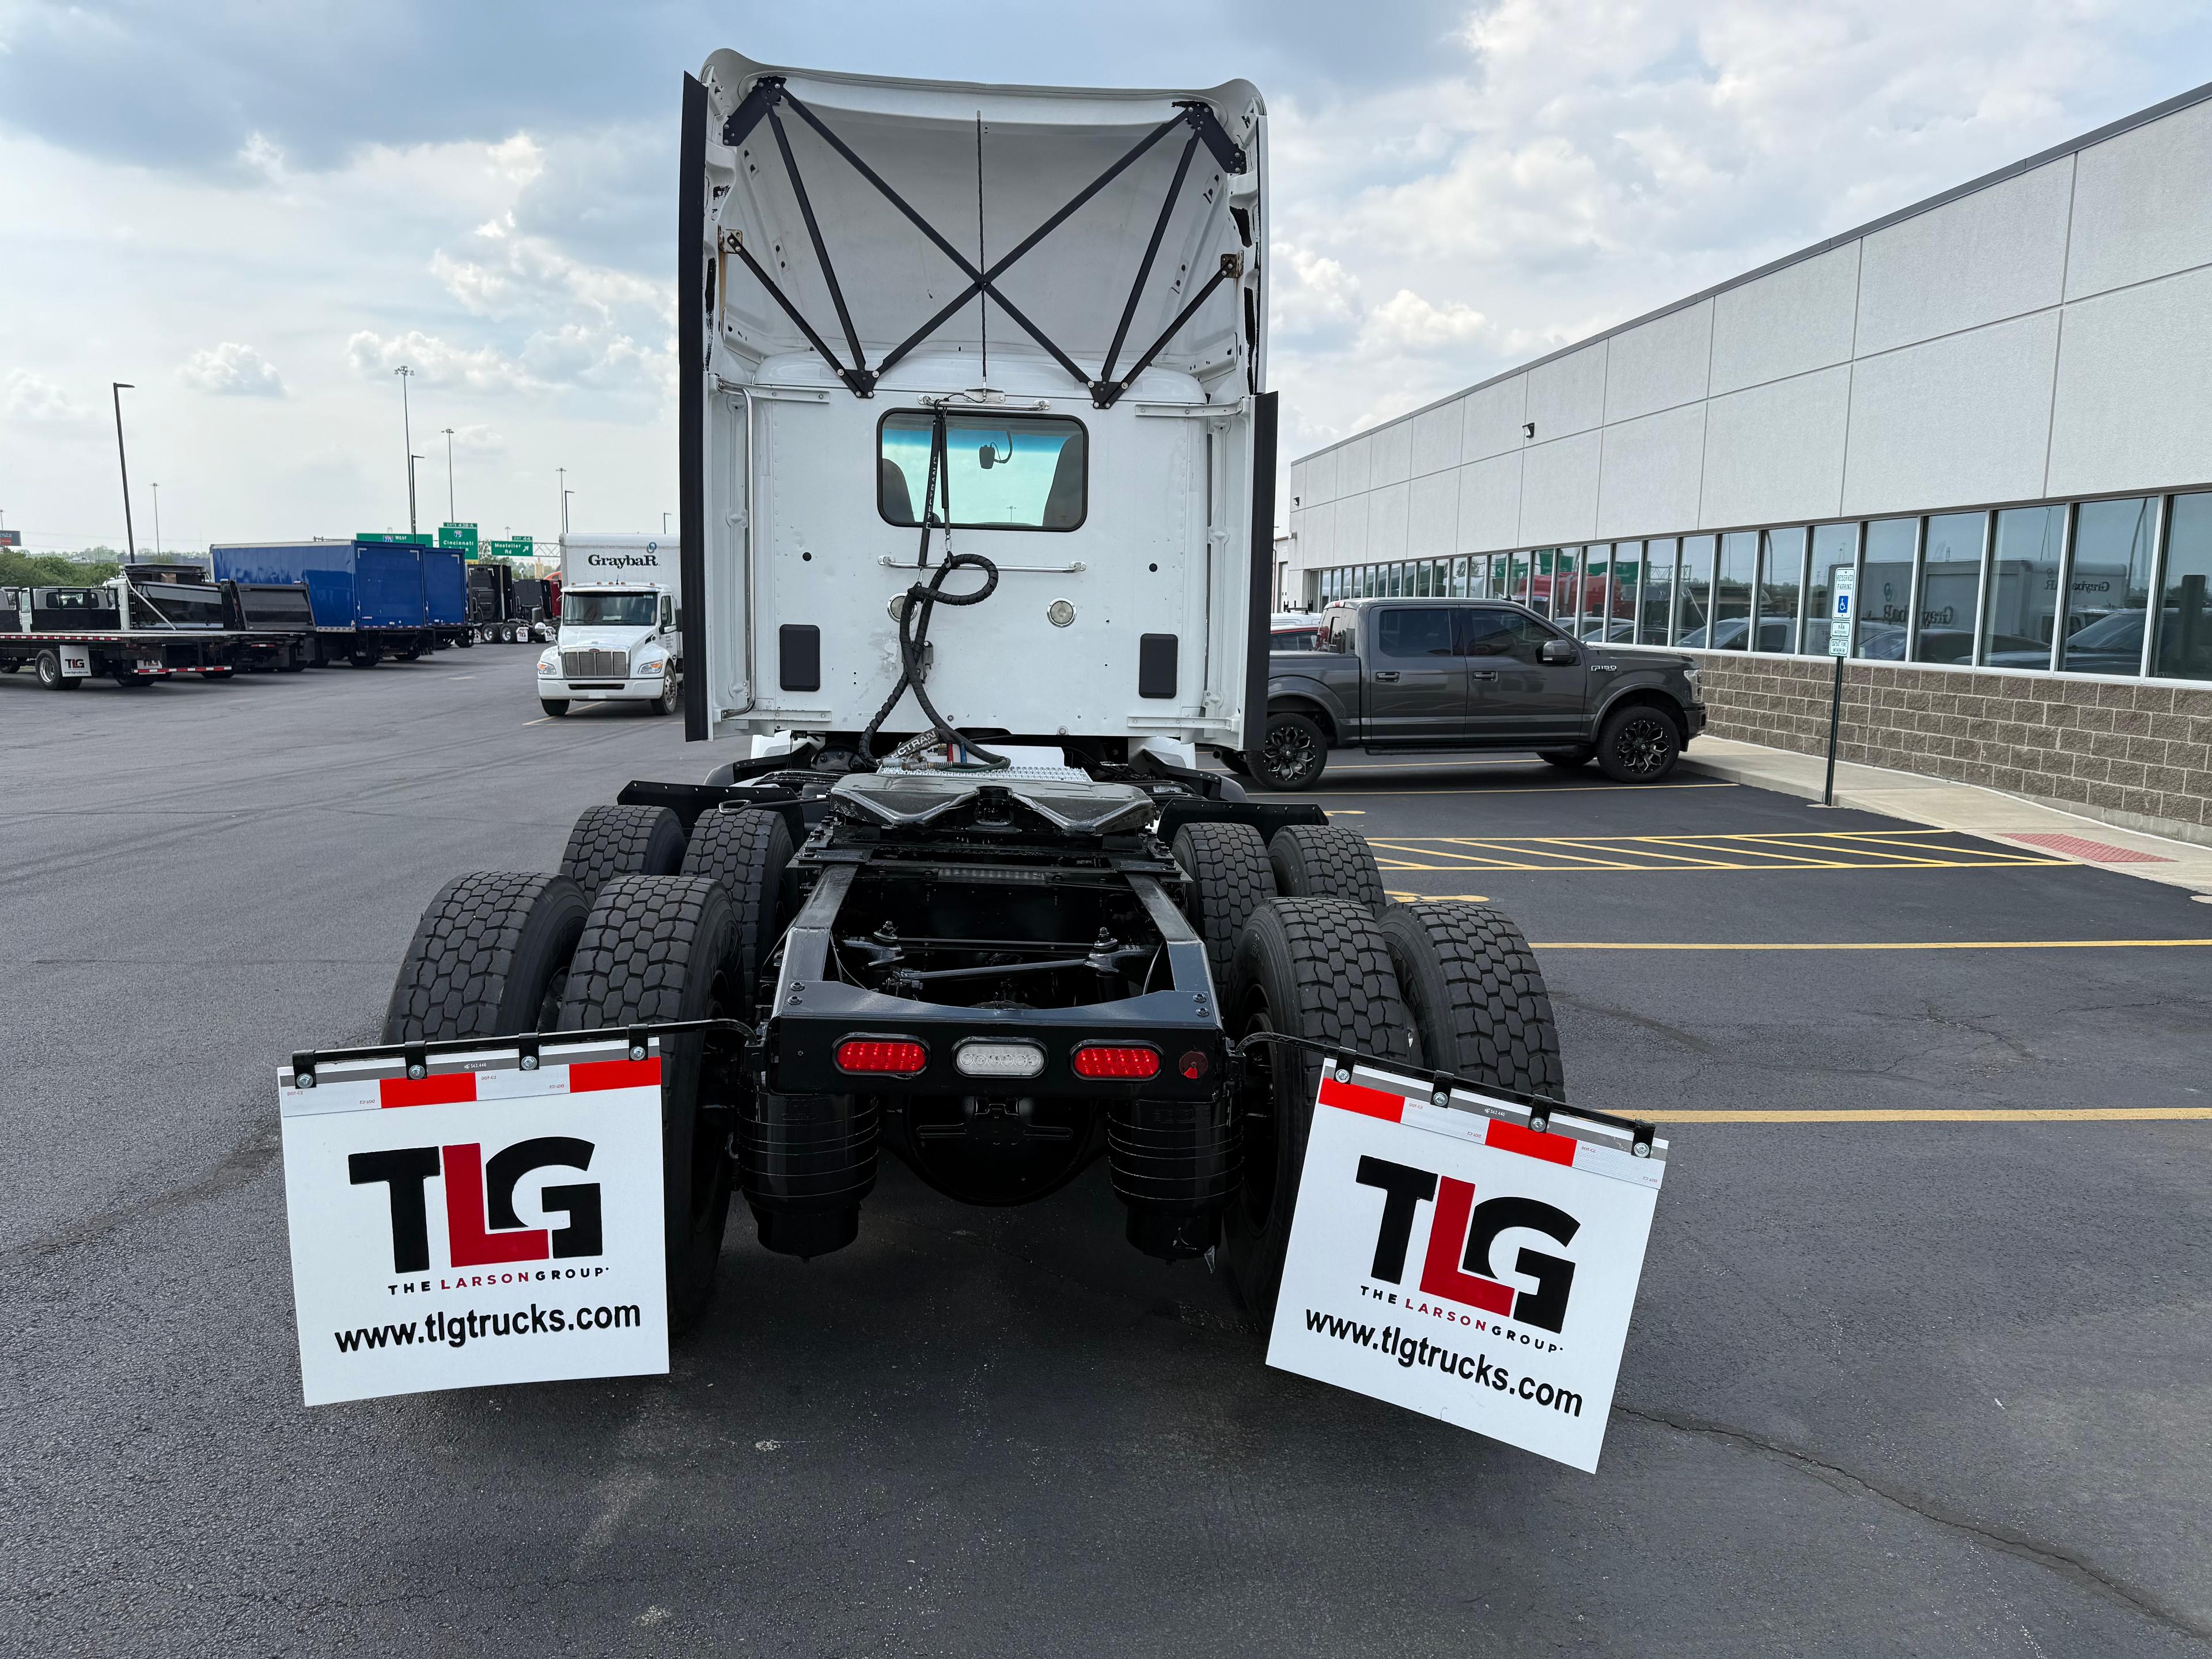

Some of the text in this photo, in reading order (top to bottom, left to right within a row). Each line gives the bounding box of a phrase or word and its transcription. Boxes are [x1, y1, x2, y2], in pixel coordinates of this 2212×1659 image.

[65, 659, 85, 668] TLG
[888, 730, 937, 759] ECTRAN
[348, 1136, 603, 1274] TLG
[1355, 1154, 1581, 1335] TLG
[388, 1281, 431, 1296] THE
[1360, 1285, 1398, 1305] THE
[335, 1303, 641, 1354] www.tlgtrucks.com
[1305, 1308, 1583, 1418] www.tlgtrucks.com
